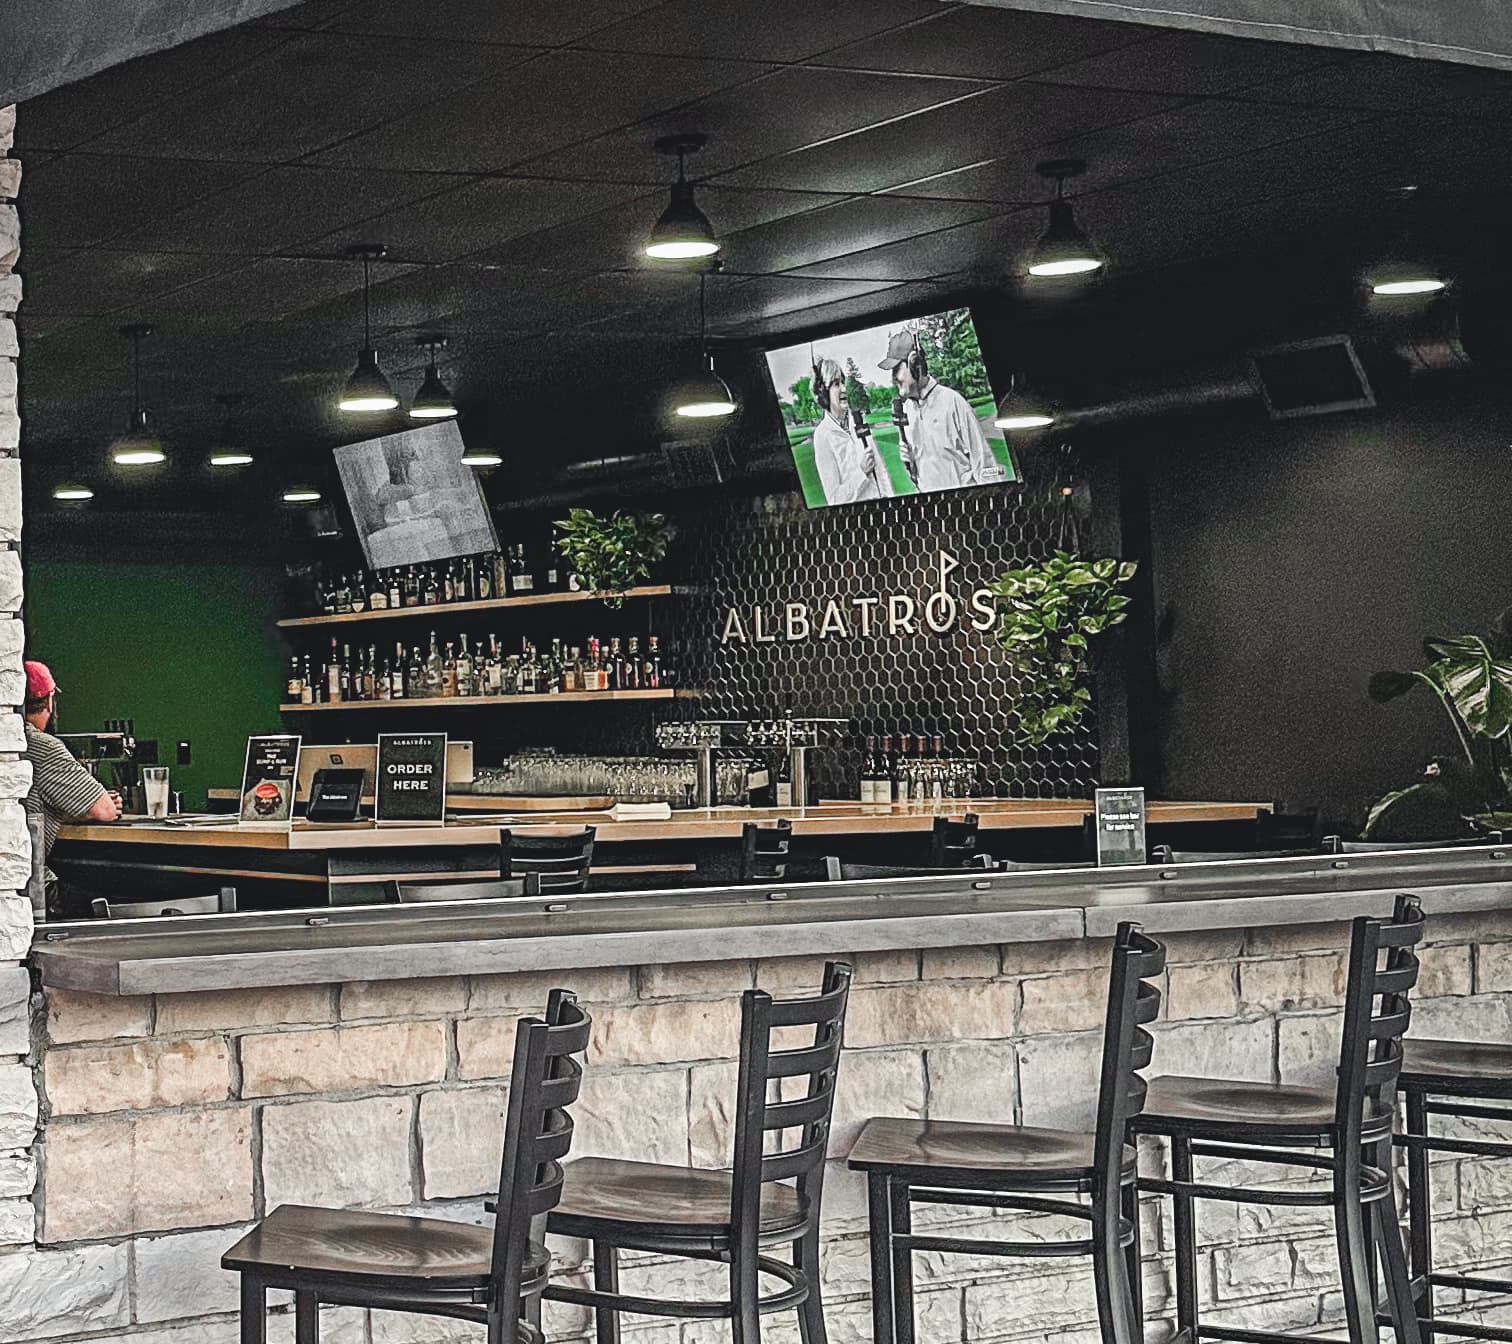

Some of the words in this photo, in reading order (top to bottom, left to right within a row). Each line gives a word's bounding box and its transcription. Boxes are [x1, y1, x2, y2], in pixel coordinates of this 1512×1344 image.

[721, 586, 1032, 645] ALBATROS
[387, 764, 433, 774] ORDER
[393, 780, 429, 790] HERE
